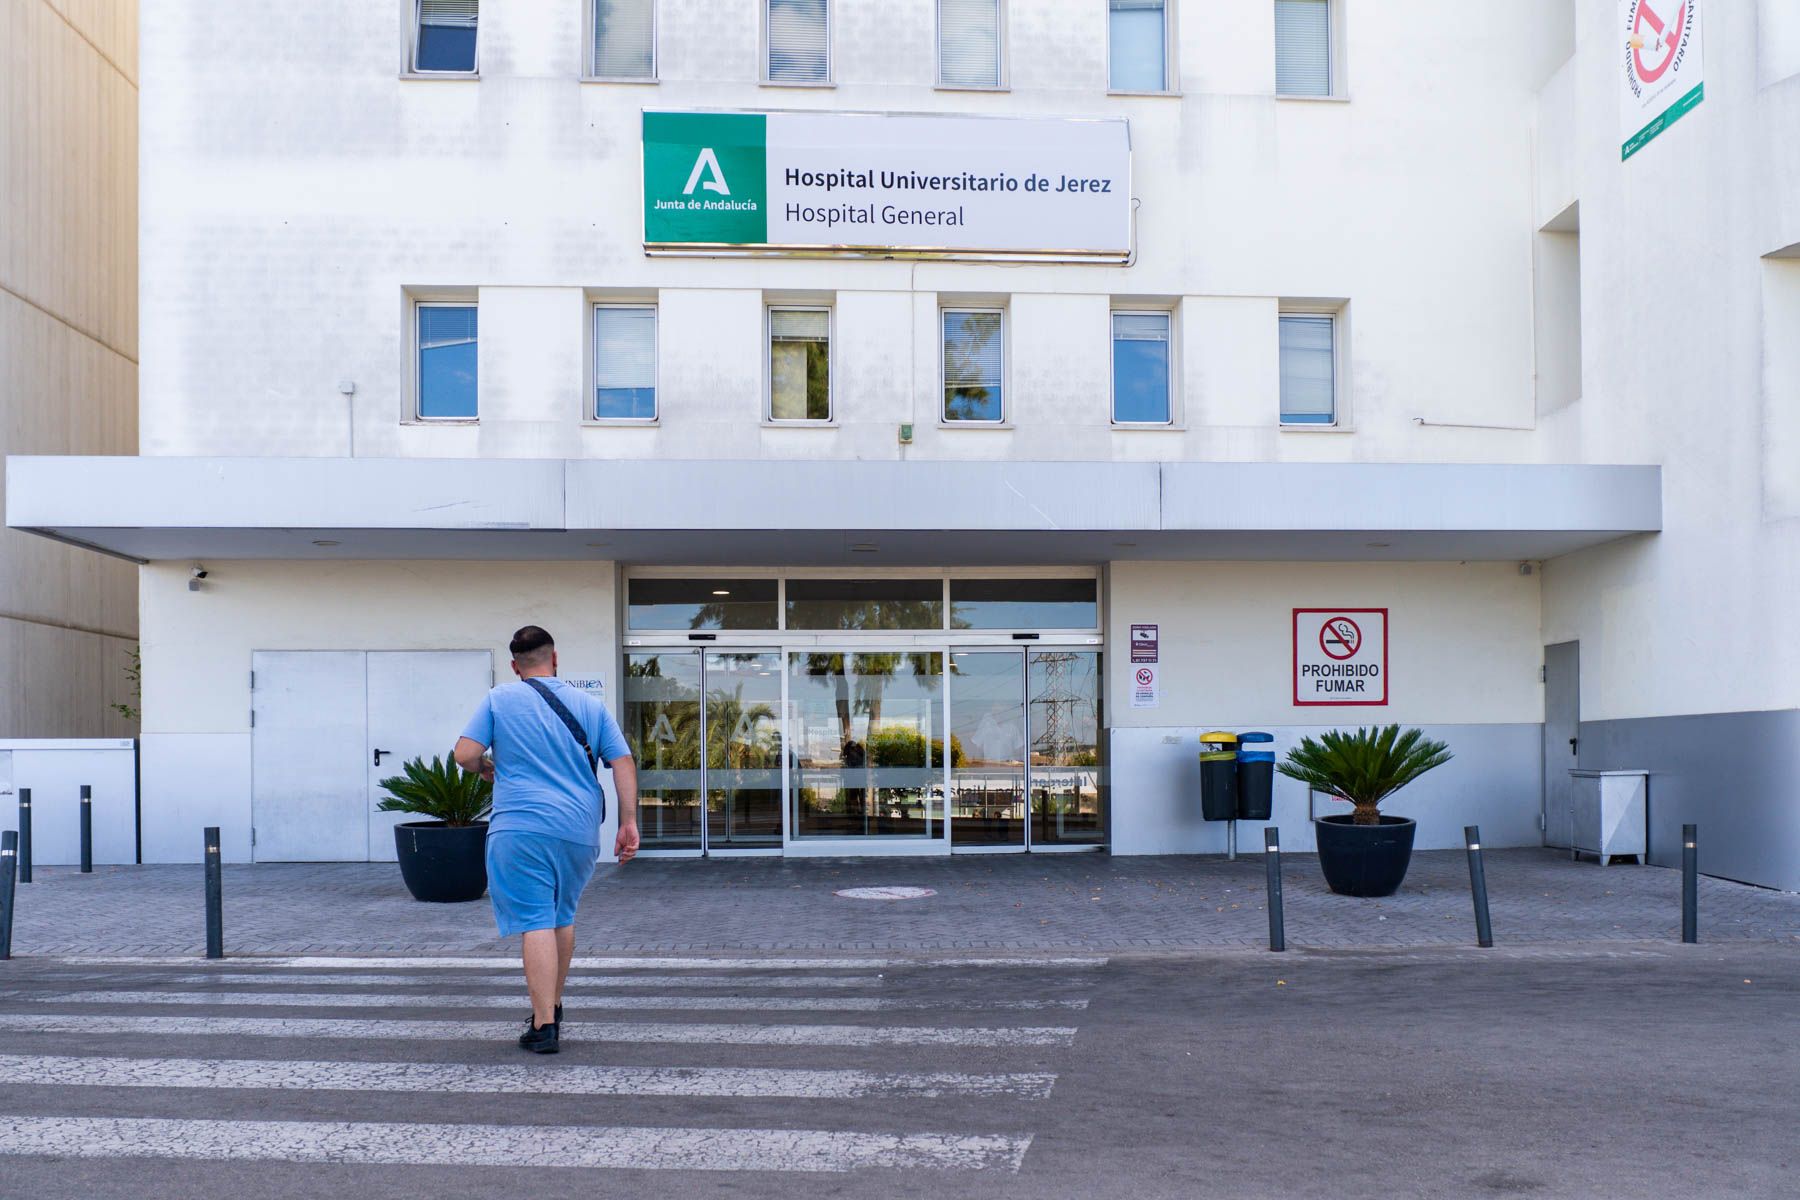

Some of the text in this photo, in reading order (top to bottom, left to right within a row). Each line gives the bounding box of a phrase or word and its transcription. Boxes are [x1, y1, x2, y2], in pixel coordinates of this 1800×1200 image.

[785, 168, 1112, 193] Hospital Universitario de Jerez
[654, 198, 758, 210] Junta de Andalucía
[785, 203, 965, 228] Hospital General
[1302, 664, 1379, 677] PROHIBIDO
[1316, 679, 1365, 692] FUMAR
